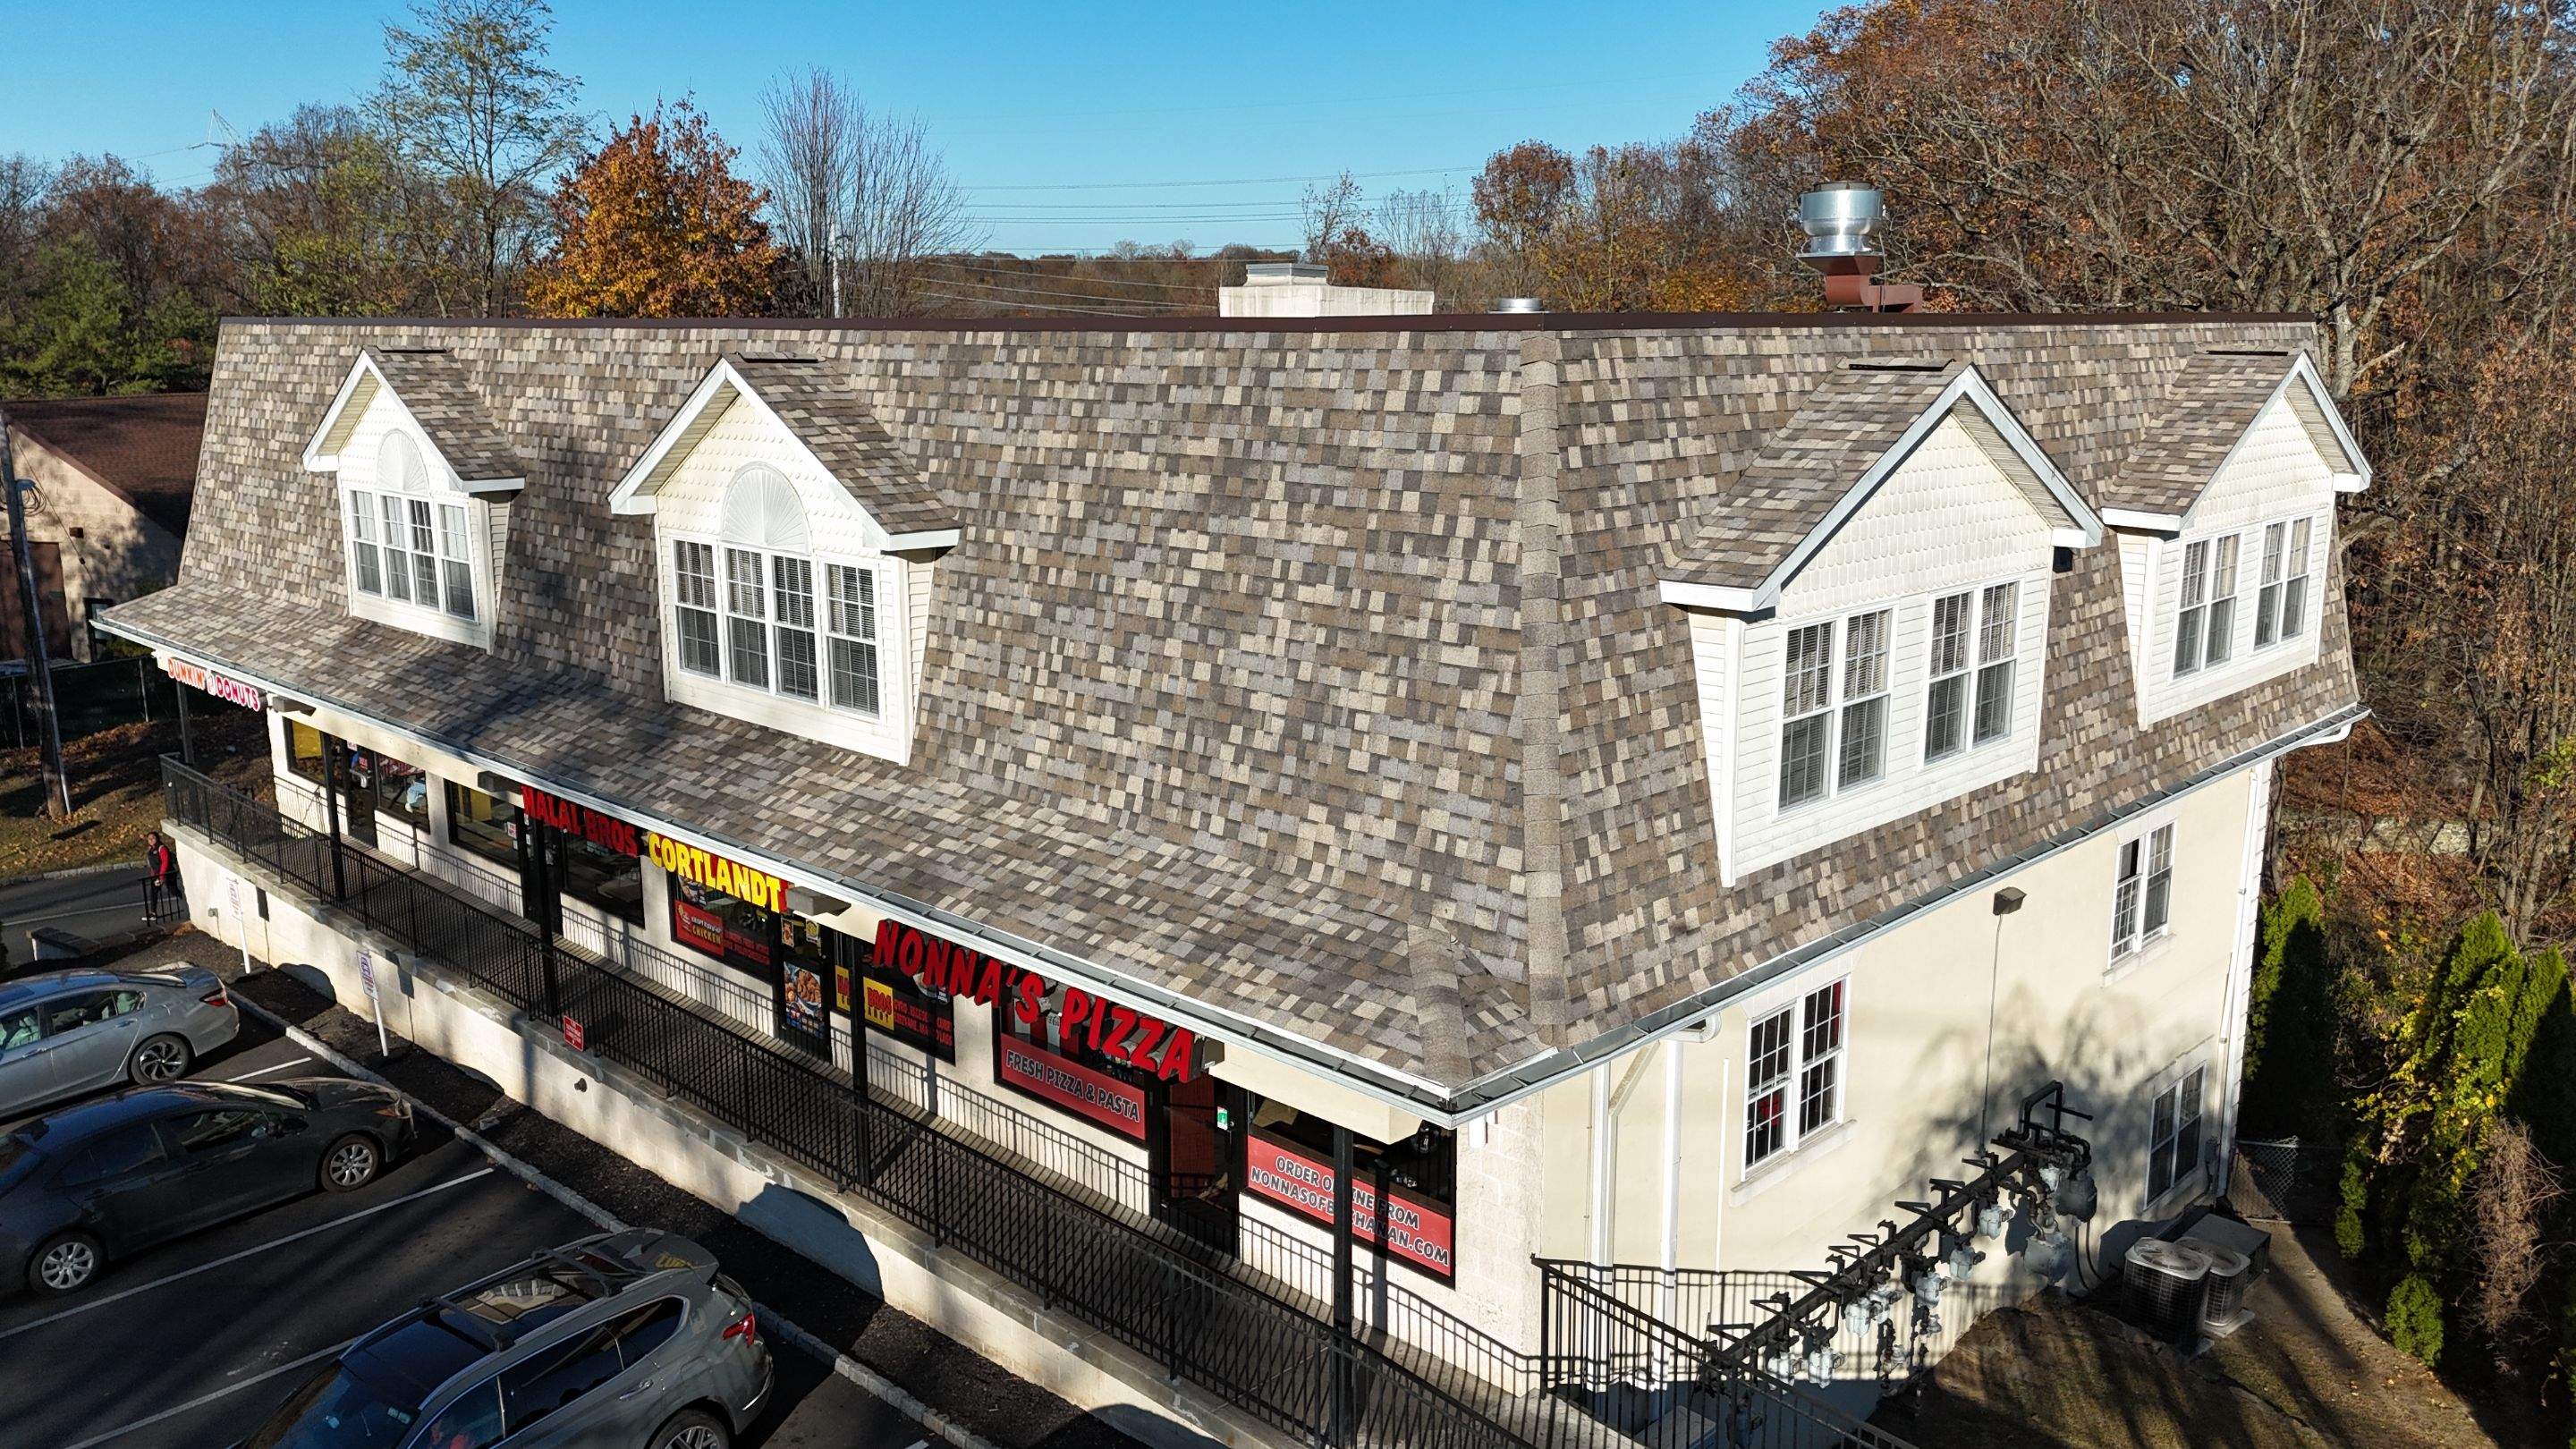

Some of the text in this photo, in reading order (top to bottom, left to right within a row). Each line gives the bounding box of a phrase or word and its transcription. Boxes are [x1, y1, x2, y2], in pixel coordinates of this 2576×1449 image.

[216, 674, 260, 712] DONUTS
[584, 809, 638, 858] BROS
[648, 833, 781, 914] CORTLANDT
[692, 925, 722, 945] CHICKEN
[872, 919, 1195, 1083] NONNA'S PIZZA
[1006, 1049, 1140, 1123] FRESH PIZZA & PASTA
[1250, 1166, 1450, 1267] NONNASOFBHANAN.COM
[1276, 1156, 1419, 1231] ORDER ONE FROM
